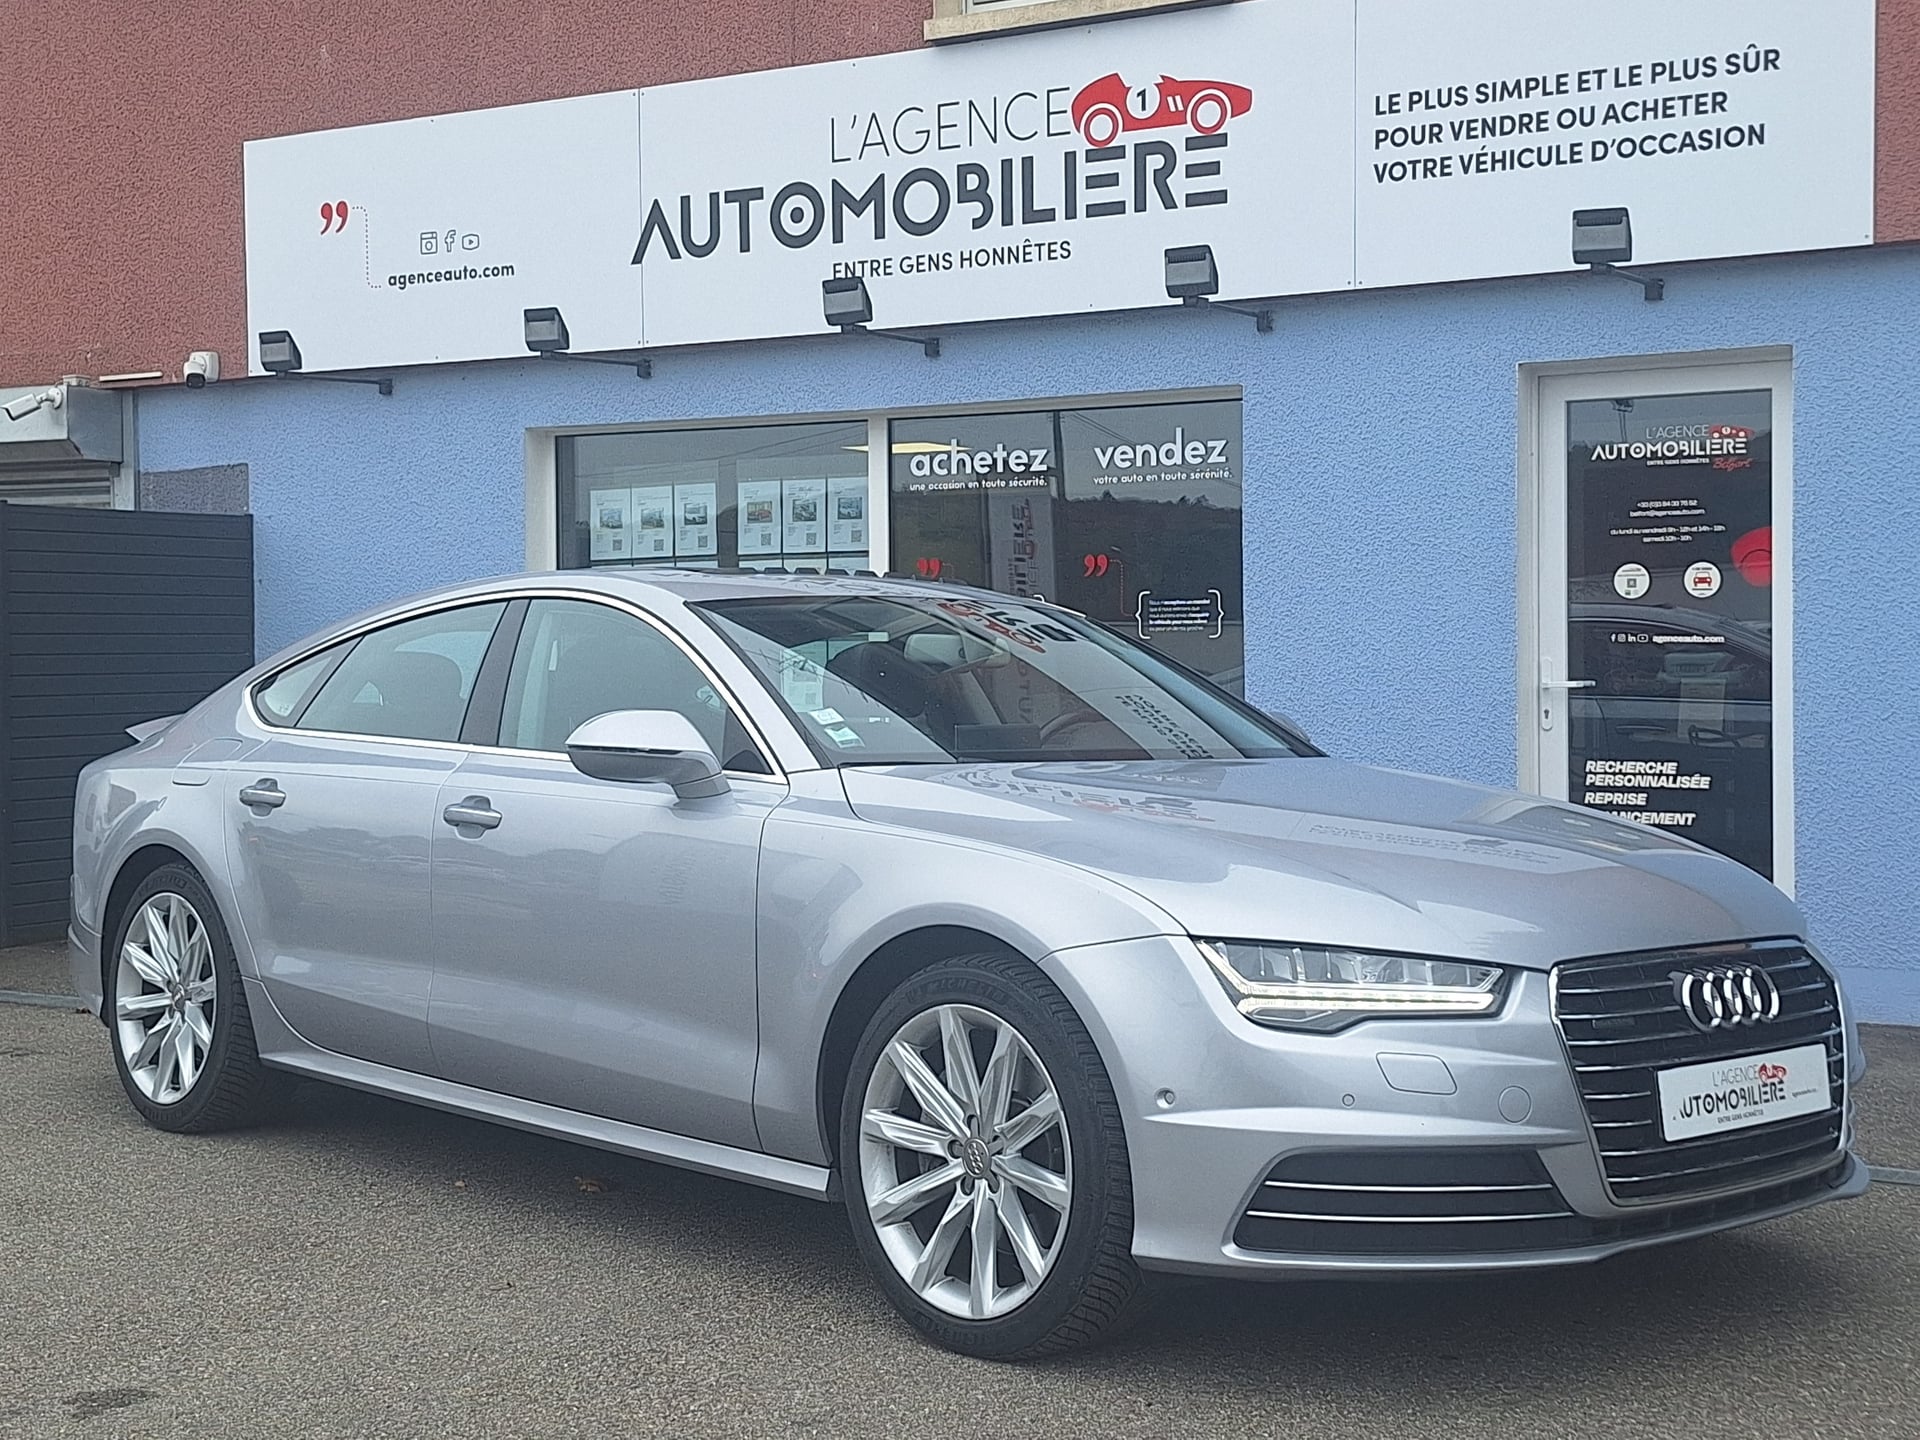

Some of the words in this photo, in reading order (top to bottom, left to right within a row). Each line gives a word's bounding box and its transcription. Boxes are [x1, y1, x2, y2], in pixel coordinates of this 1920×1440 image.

[1374, 93, 1401, 116] LE
[1407, 84, 1469, 112] PLUS
[1475, 72, 1570, 105] SIMPLE
[1576, 67, 1608, 92] ET
[1614, 64, 1643, 89] LE
[1651, 56, 1718, 85] PLUS
[1724, 44, 1782, 76] SÛR
[831, 86, 1072, 163] L'AGENCE
[1374, 123, 1443, 151] POUR
[1449, 111, 1550, 142] VENDRE
[1556, 105, 1596, 130] OU
[1601, 91, 1729, 126] ACHETER
[1373, 155, 1453, 184] VOTRE
[1458, 143, 1583, 176] VÉHICULE
[1591, 123, 1766, 162] D'OCCASION
[832, 258, 894, 280] ENTRE
[900, 251, 954, 274] GENS
[959, 239, 1072, 268] HONNÊTES
[388, 264, 515, 291] agenceauto.com
[1093, 427, 1228, 470] vendez
[1645, 424, 1709, 440] L'AGENCE
[910, 438, 1048, 478] achetez
[909, 483, 927, 492] une
[928, 480, 965, 491] occasion
[968, 481, 980, 489] en
[982, 478, 1007, 488] toute
[1093, 476, 1118, 486] votre
[1121, 474, 1143, 484] auto
[1146, 475, 1158, 483] en
[1160, 471, 1187, 482] toute
[1585, 760, 1678, 775] RECHERCHE
[1585, 773, 1711, 789] PERSONNALISÉE
[1584, 792, 1648, 806] REPRISE
